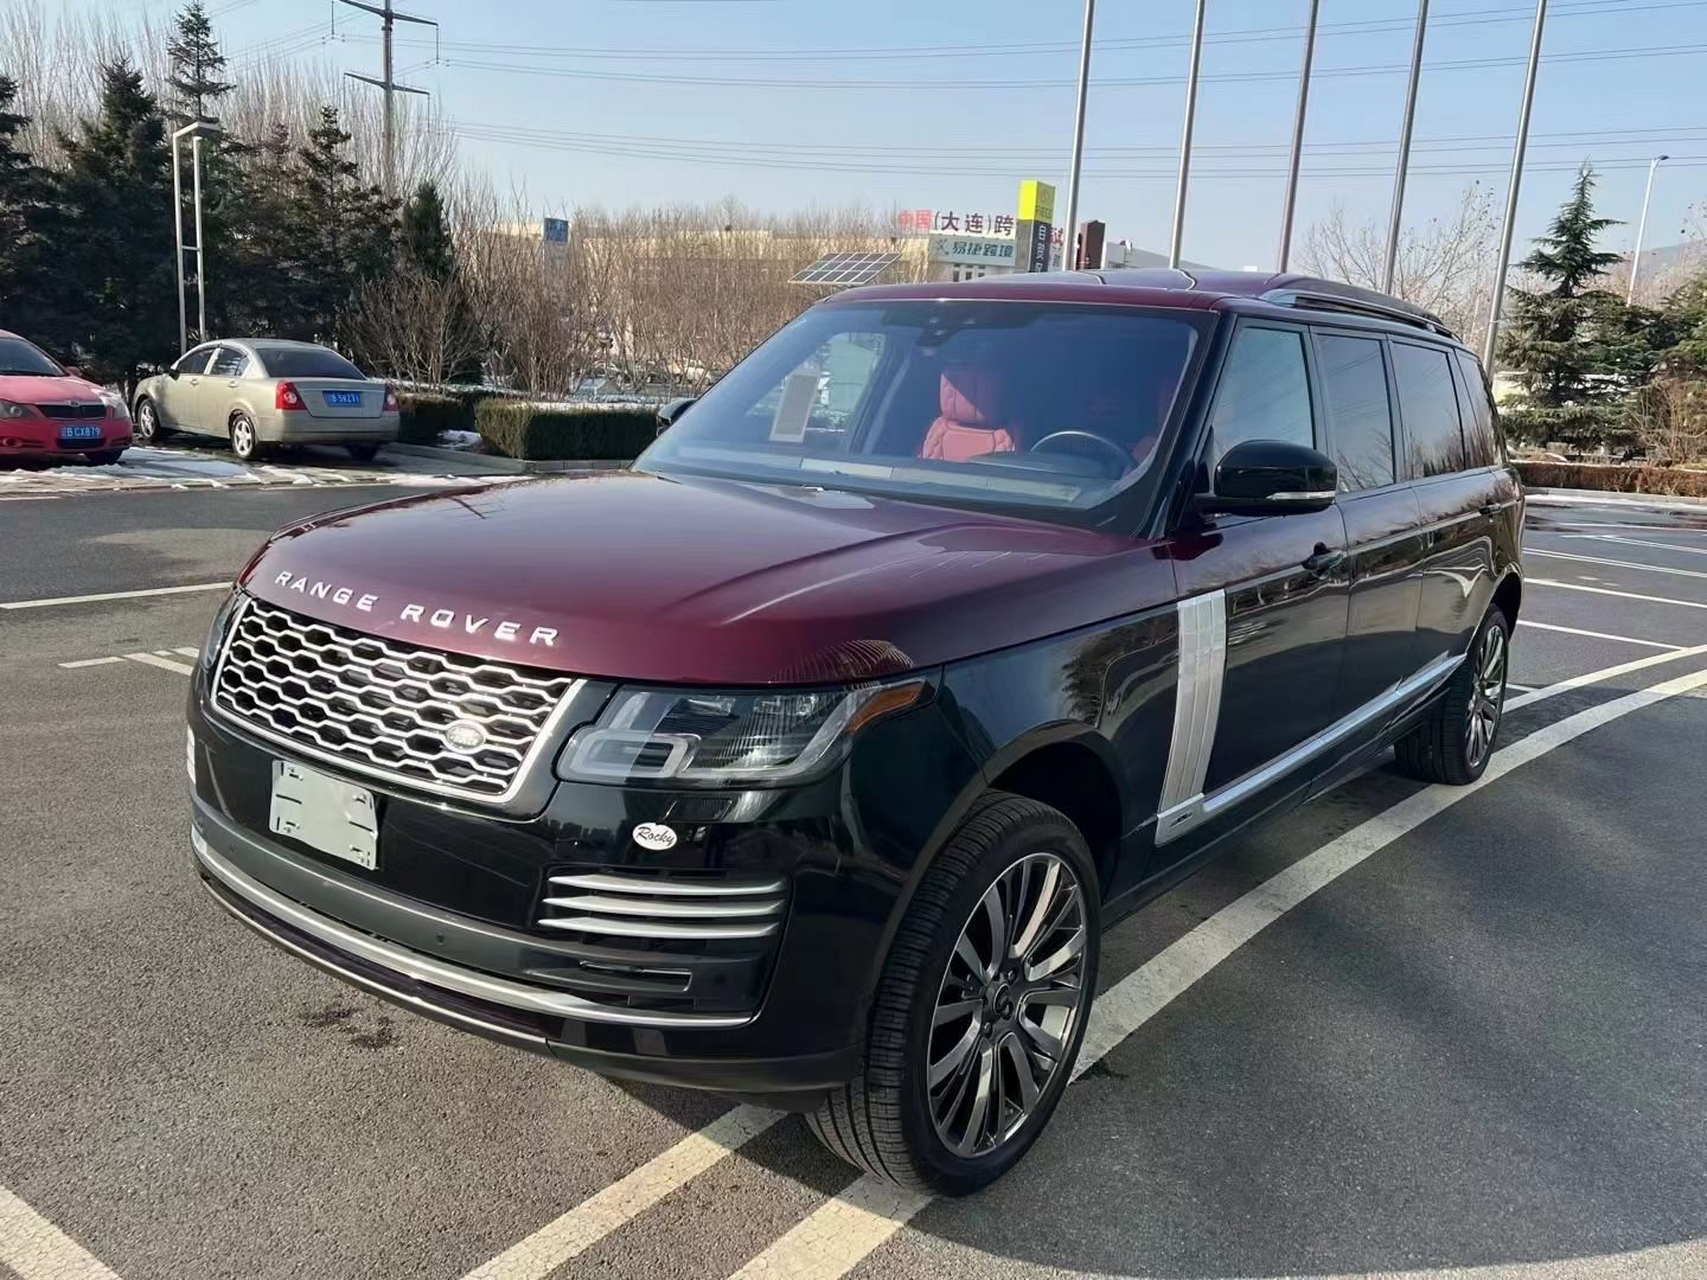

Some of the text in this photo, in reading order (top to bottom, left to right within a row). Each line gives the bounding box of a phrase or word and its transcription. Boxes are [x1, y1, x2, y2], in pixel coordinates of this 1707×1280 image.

[274, 570, 560, 646] RANGE ROVER
[636, 826, 675, 847] Rocky
